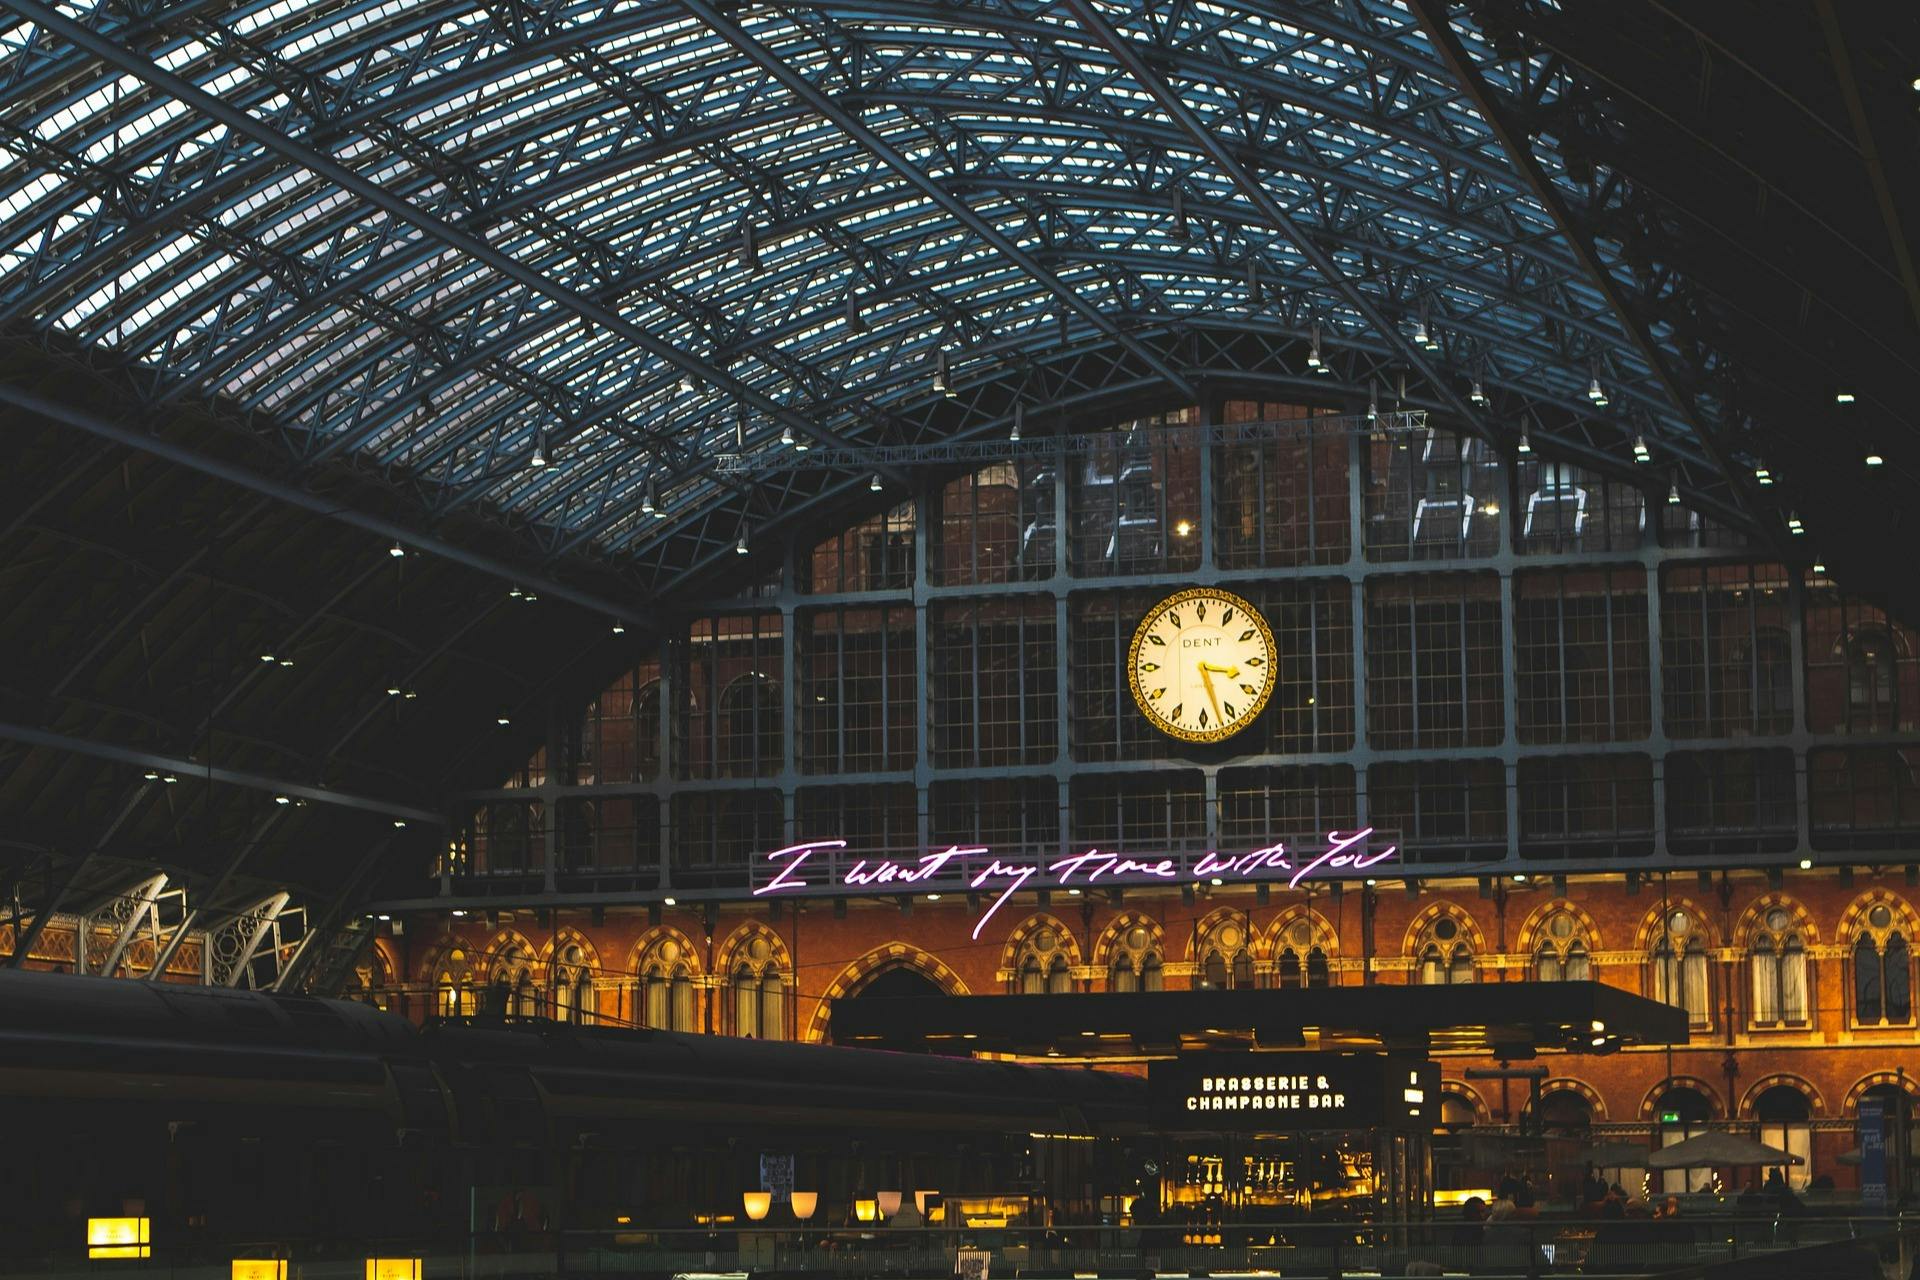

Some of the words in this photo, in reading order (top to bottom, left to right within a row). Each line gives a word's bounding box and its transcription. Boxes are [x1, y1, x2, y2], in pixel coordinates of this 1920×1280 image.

[1183, 637, 1222, 649] DENT
[753, 839, 847, 896] I
[1288, 827, 1396, 889] You
[1202, 1076, 1309, 1092] BRASSERIE
[1317, 1076, 1330, 1090] &
[1187, 1095, 1300, 1111] CHAMPAGNE
[1308, 1094, 1345, 1109] BAR
